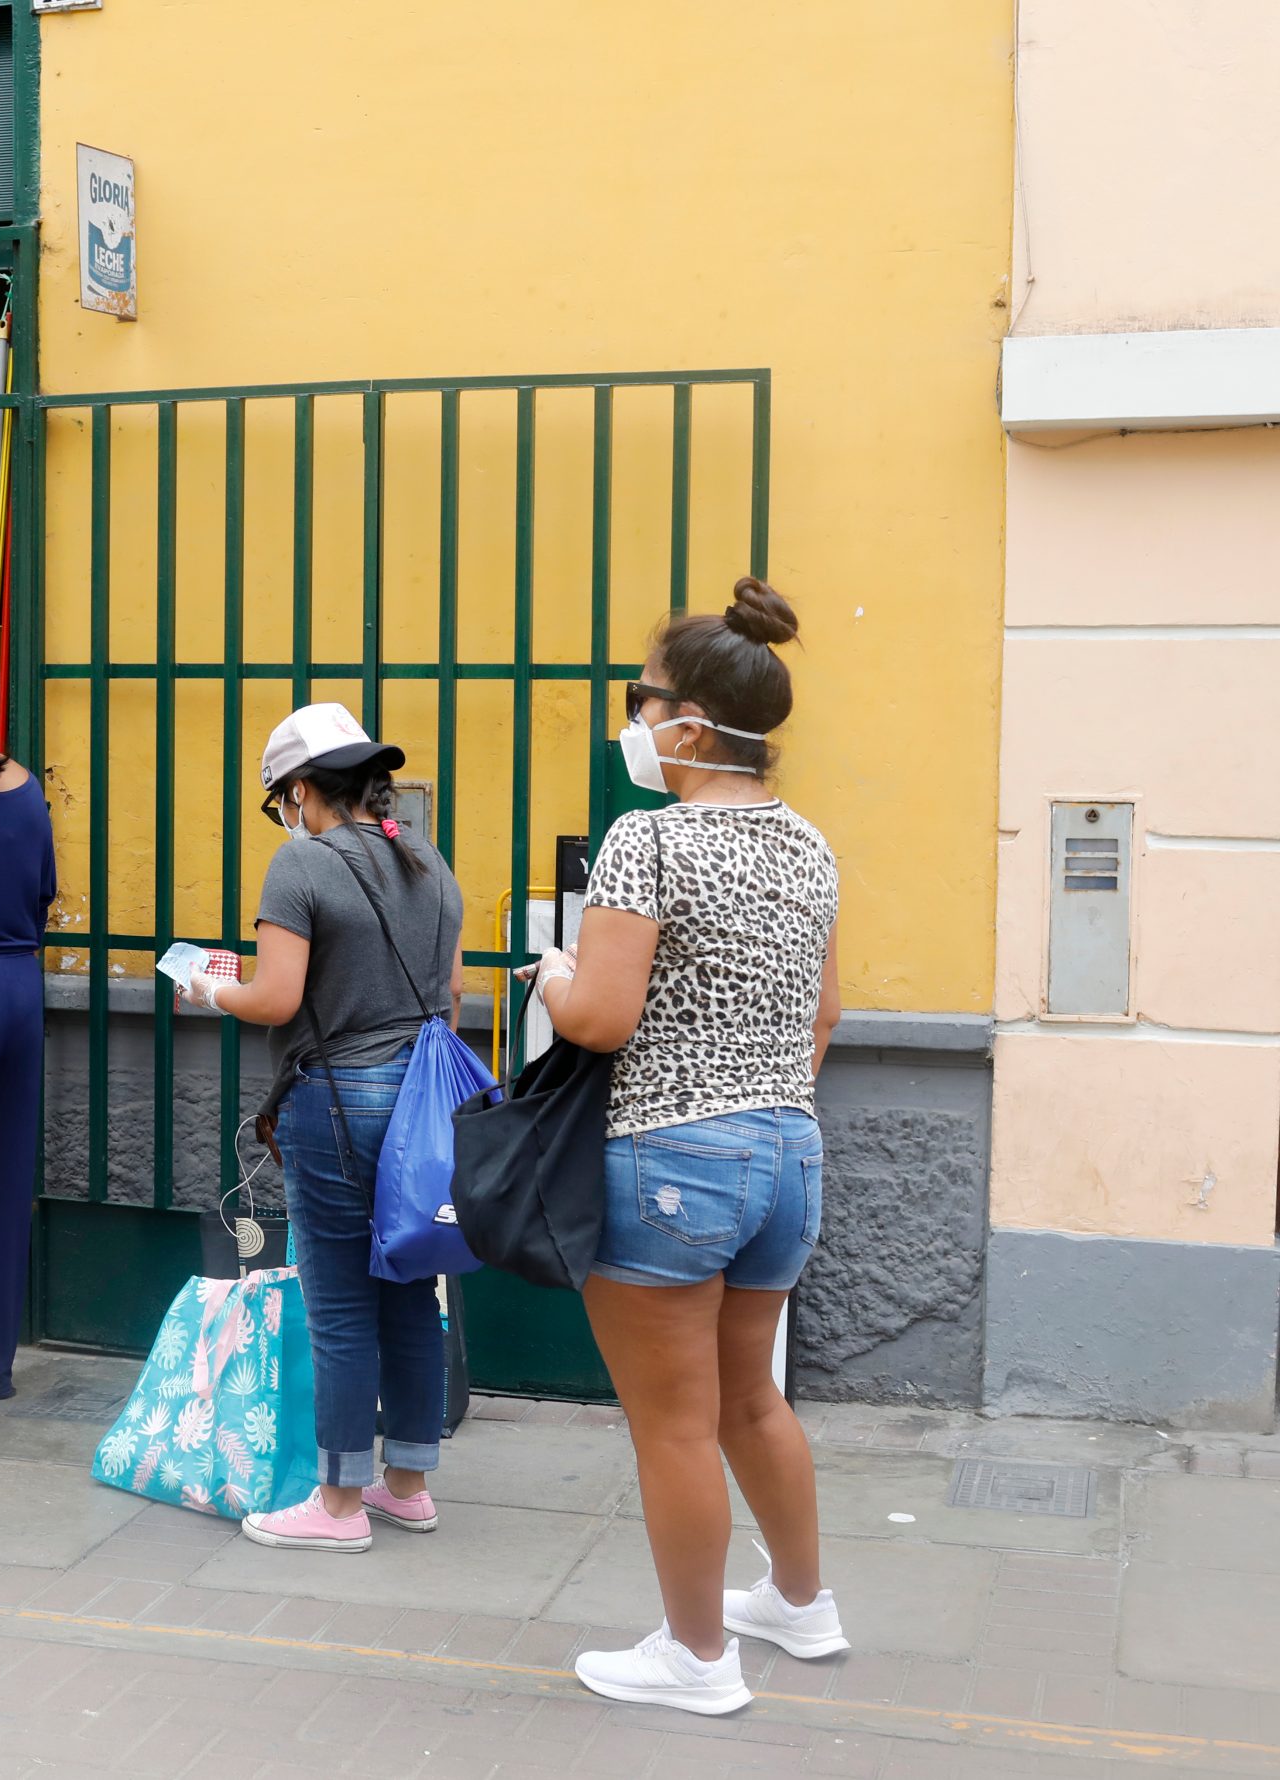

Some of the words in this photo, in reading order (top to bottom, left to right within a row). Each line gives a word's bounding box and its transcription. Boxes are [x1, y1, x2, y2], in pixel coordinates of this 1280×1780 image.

[90, 172, 130, 217] GLORIA
[94, 243, 125, 272] LECHE
[434, 1204, 458, 1225] S
